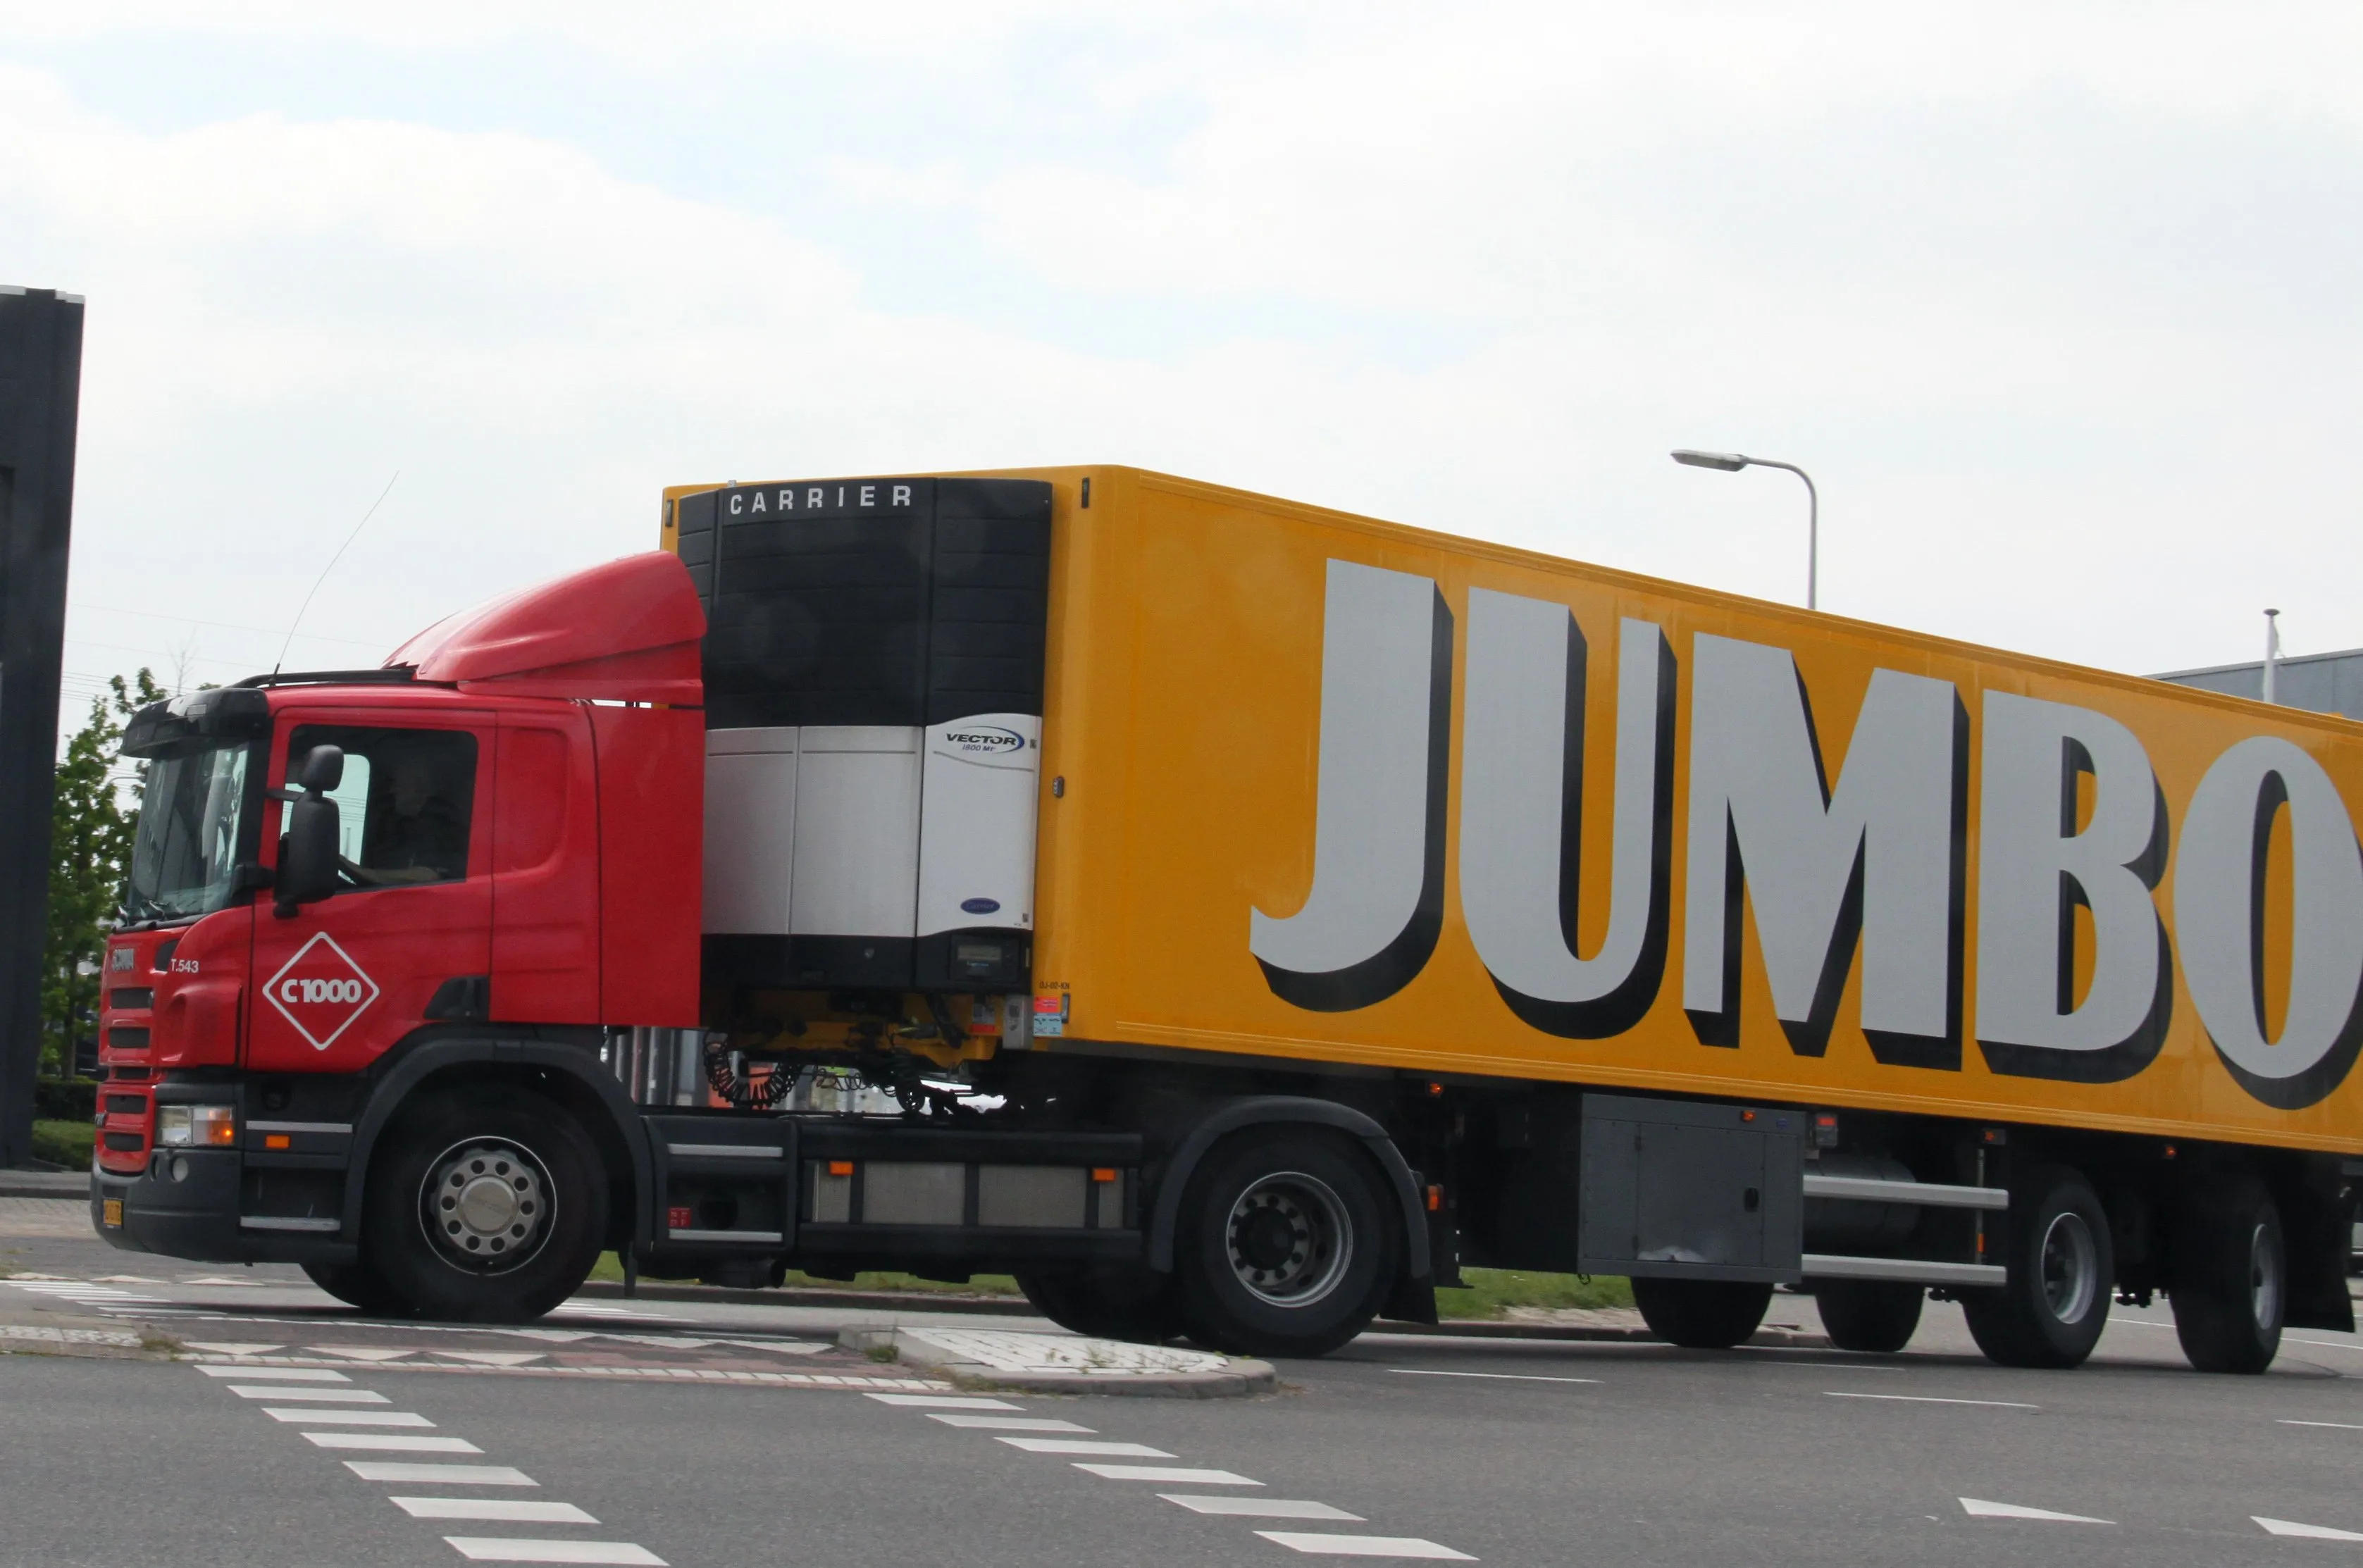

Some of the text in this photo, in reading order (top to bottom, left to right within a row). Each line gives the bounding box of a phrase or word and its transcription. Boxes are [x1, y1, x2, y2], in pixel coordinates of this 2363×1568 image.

[730, 485, 912, 515] CARRIER
[946, 733, 1017, 746] VECTOR
[1250, 556, 2363, 1110] JUMBO
[171, 958, 199, 973] T.543
[280, 978, 362, 1003] C1000
